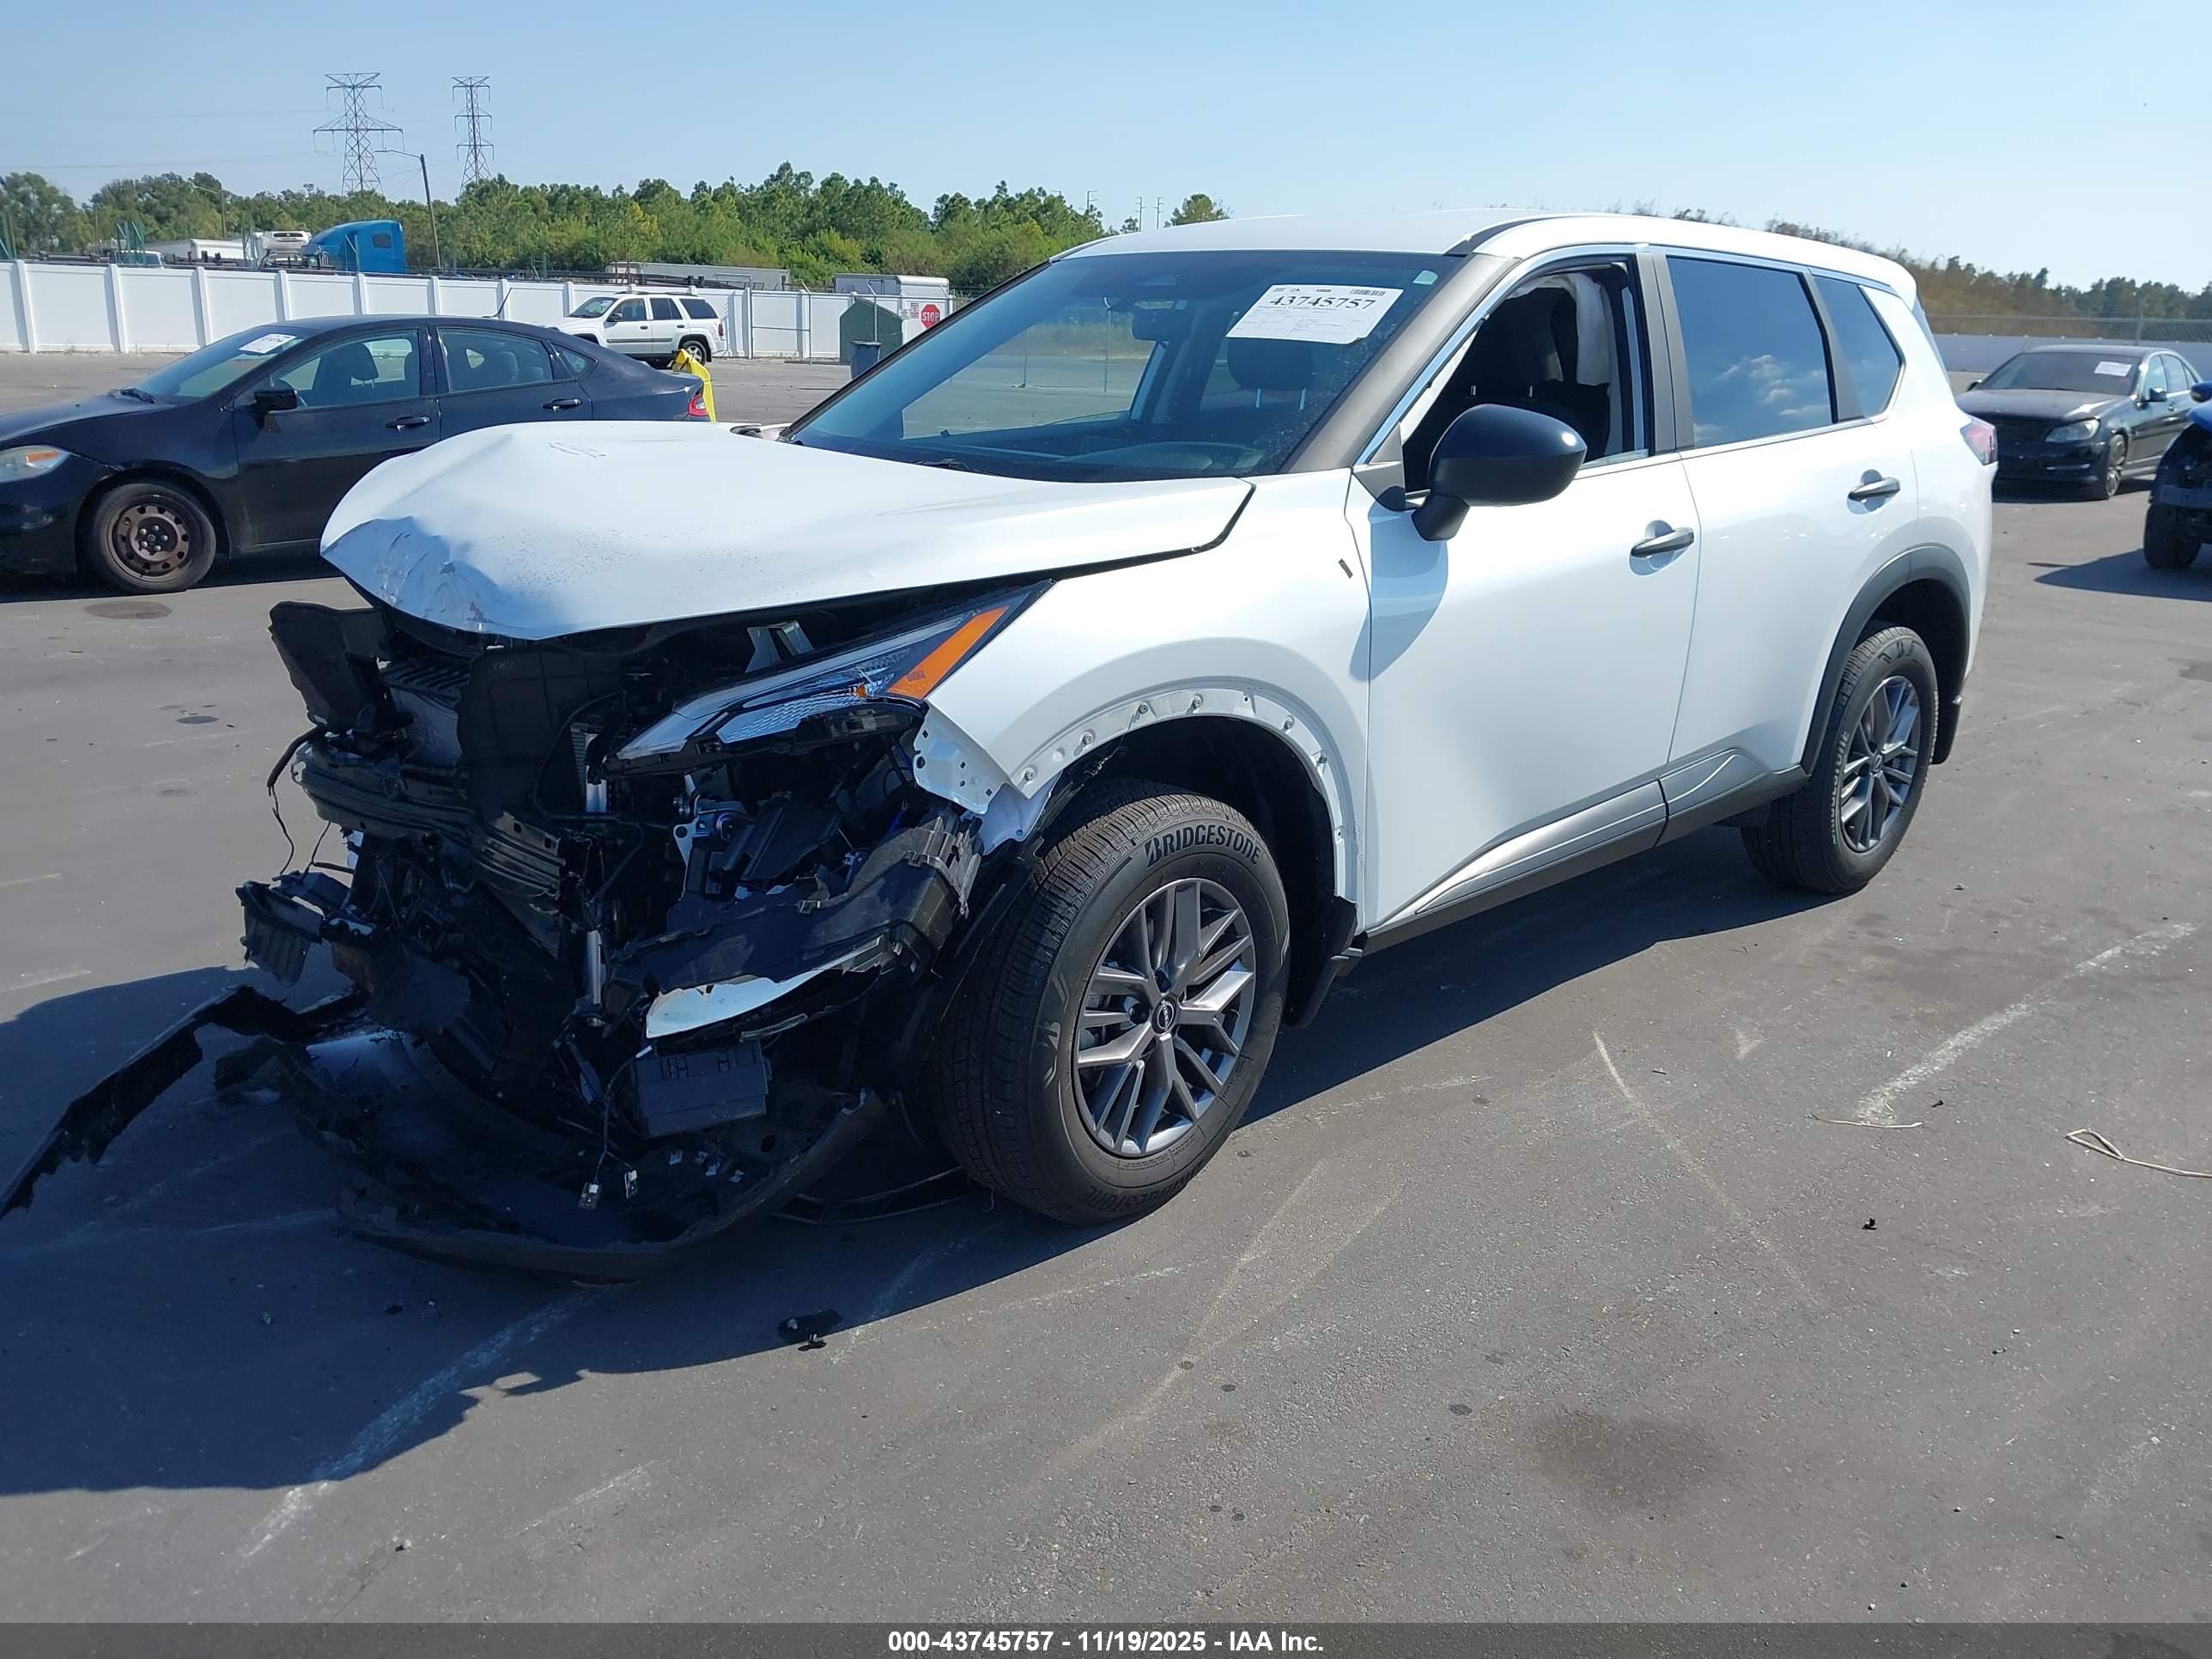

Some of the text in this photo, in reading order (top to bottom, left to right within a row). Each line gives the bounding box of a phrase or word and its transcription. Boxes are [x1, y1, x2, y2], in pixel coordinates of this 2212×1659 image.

[1269, 295, 1376, 310] 43745757
[922, 312, 939, 322] STOP
[1144, 823, 1261, 869] BRIDGESTONE
